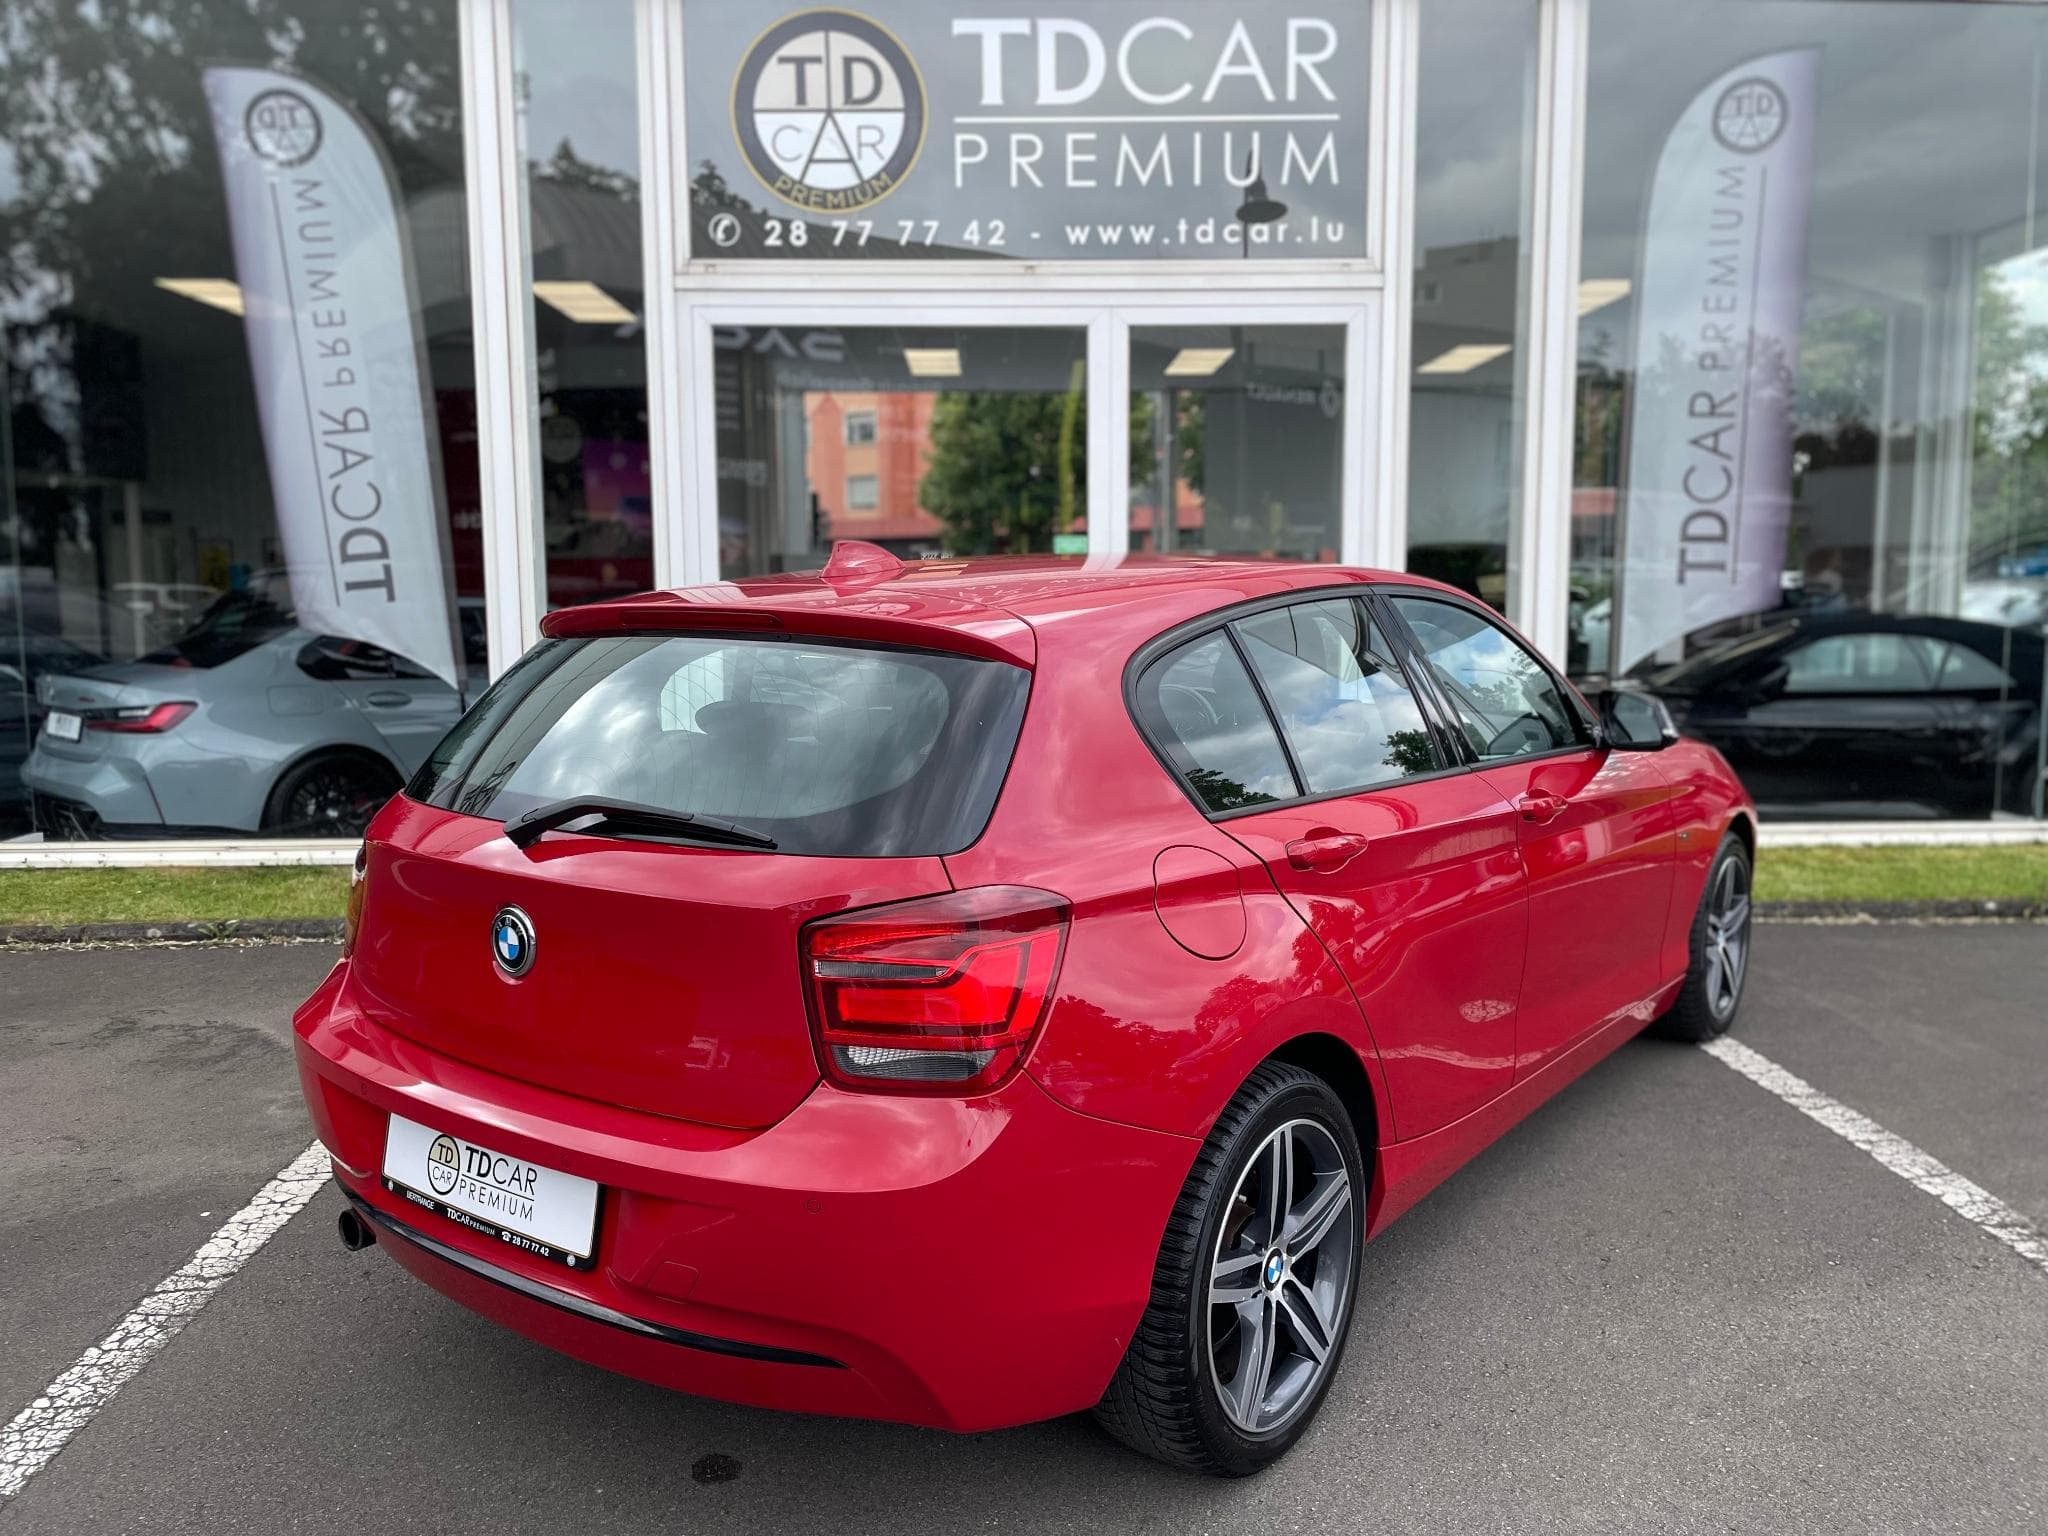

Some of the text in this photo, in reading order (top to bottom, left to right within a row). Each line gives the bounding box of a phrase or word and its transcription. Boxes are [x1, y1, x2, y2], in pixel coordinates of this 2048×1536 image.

[777, 55, 883, 106] TD
[952, 17, 1339, 106] TDCAR
[772, 112, 885, 184] CAR
[954, 131, 1340, 189] PREMIUM
[774, 171, 893, 210] PREMIUM
[763, 219, 808, 247] 28
[832, 219, 874, 247] 77
[898, 219, 940, 247] 77
[963, 219, 1006, 247] 42
[1065, 216, 1344, 245] www.tdcar.lu
[1677, 164, 1747, 586] TDCAR PREMIUM
[432, 1166, 452, 1185] CAR
[437, 1143, 454, 1164] TD
[465, 1145, 538, 1196] TDCAR
[459, 1179, 533, 1222] PREMIUM
[512, 1235, 521, 1246] 28
[521, 1238, 530, 1249] 77
[531, 1242, 540, 1252] 77
[540, 1246, 549, 1257] 42
